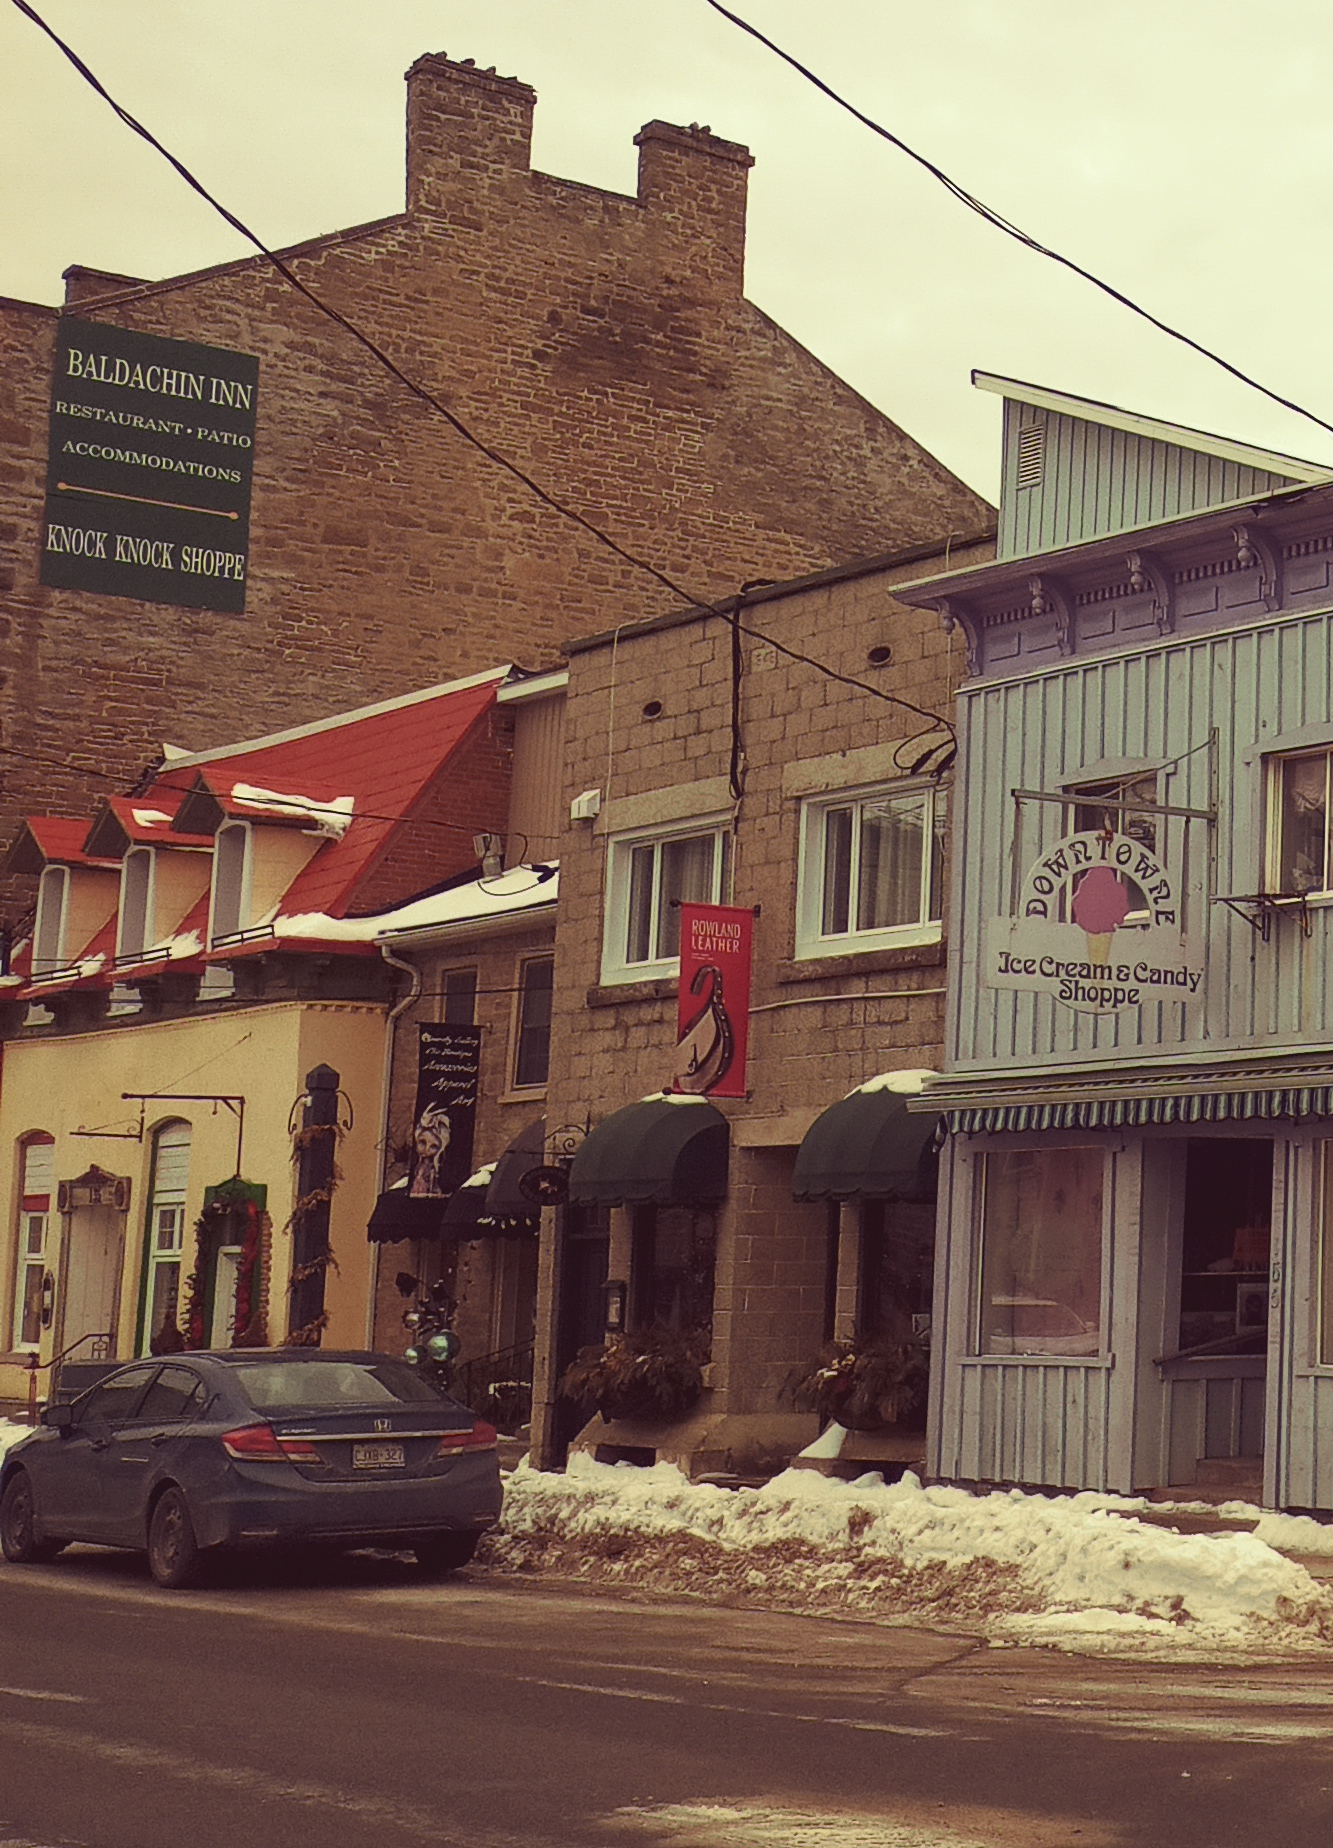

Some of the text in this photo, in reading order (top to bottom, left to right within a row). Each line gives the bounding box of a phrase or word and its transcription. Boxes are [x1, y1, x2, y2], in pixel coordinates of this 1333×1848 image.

[66, 348, 253, 410] BALDACHIN INN
[55, 400, 252, 449] RESTAURANT PATIO
[61, 440, 243, 484] ACCOMMODATIONS
[46, 523, 245, 581] KNOCK KNOCK SHOPPE
[1025, 836, 1176, 926] DOWNTOWNE
[692, 919, 741, 939] ROWLAND
[692, 936, 740, 953] LEATHER
[998, 951, 1203, 994] Ice Cream & Candy
[1058, 978, 1140, 1009] Shoppe
